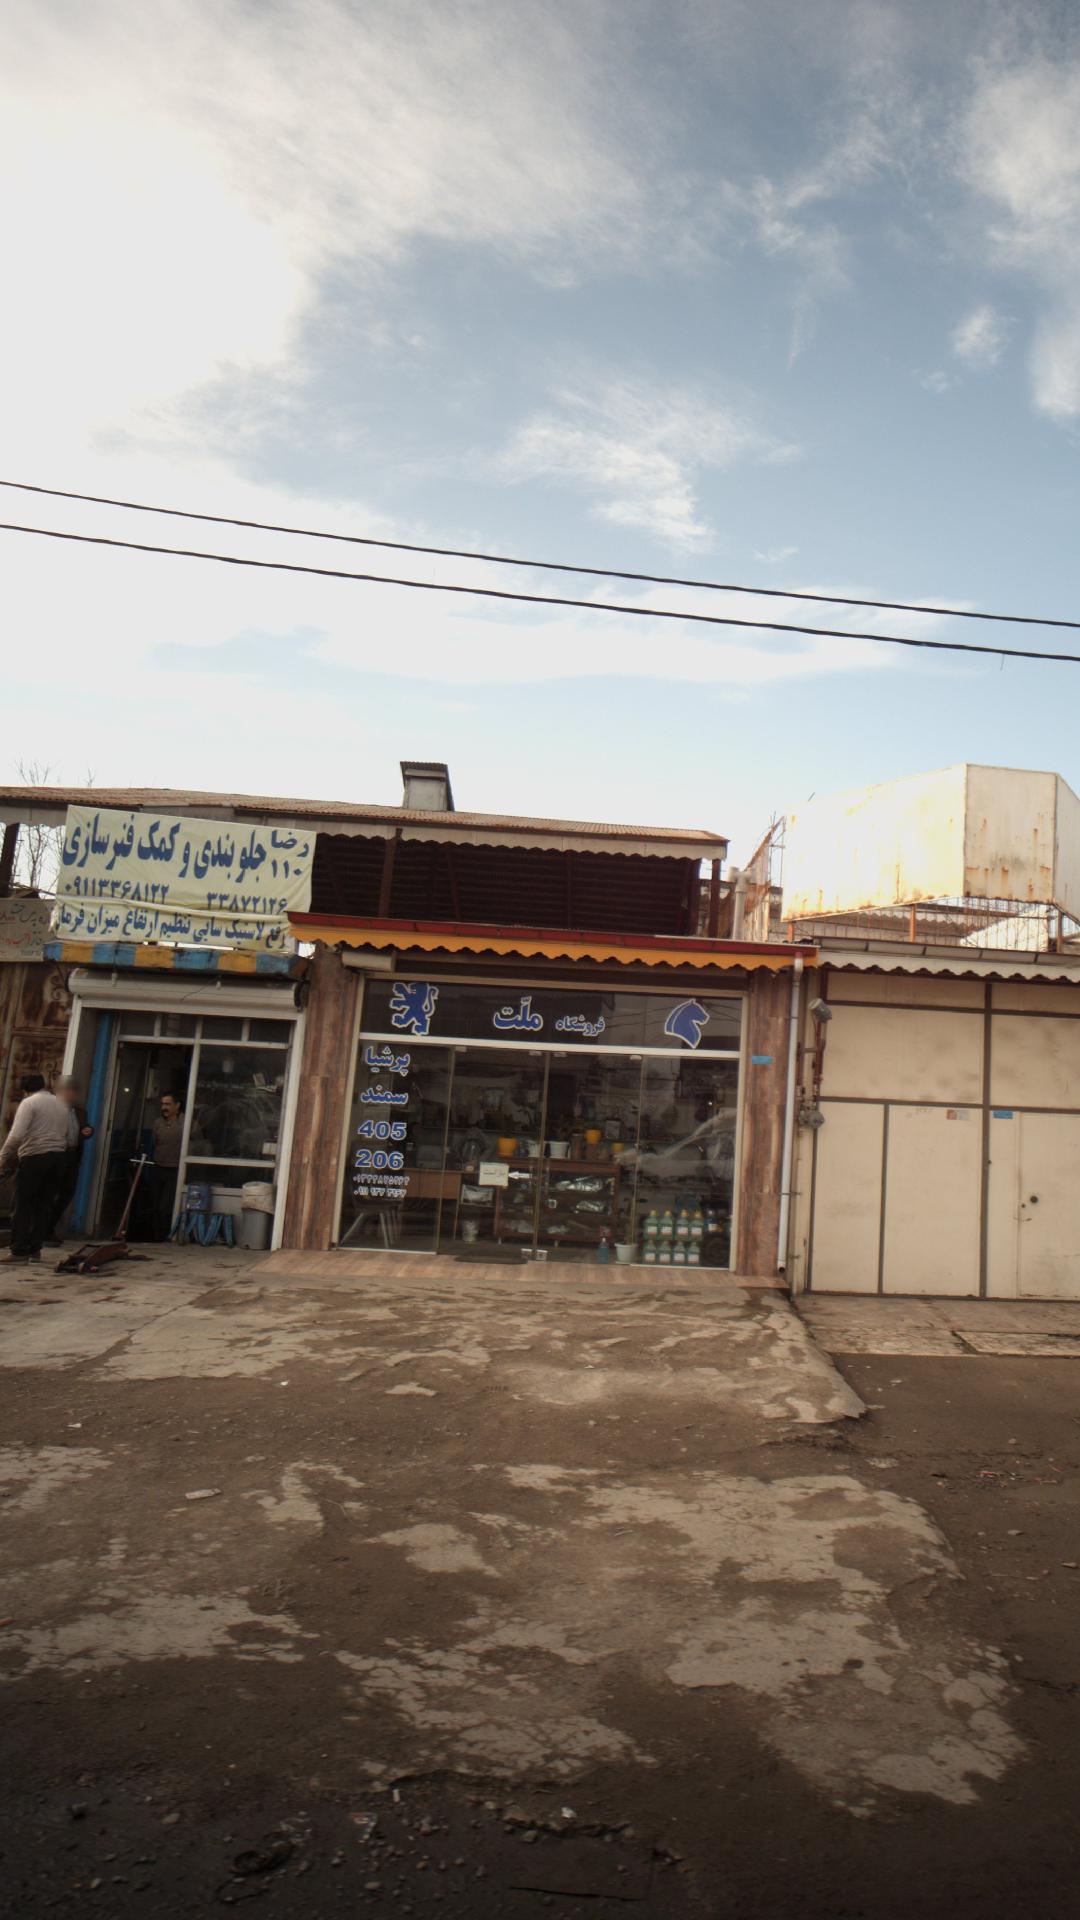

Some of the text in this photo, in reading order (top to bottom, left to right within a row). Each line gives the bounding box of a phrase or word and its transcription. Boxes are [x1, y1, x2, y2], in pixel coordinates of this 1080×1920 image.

[137, 820, 181, 862] کمک
[271, 829, 310, 857] رضا
[178, 841, 191, 878] و
[271, 859, 303, 879] ۱۱۰
[87, 902, 120, 935] میزان
[122, 907, 160, 938] ارتفاع
[159, 911, 191, 939] تنظیم
[555, 1014, 606, 1037] فروشگاه
[365, 1045, 411, 1077] پرشیا
[360, 1084, 409, 1105] سمند
[357, 1119, 408, 1141] 405
[354, 1148, 405, 1171] 206
